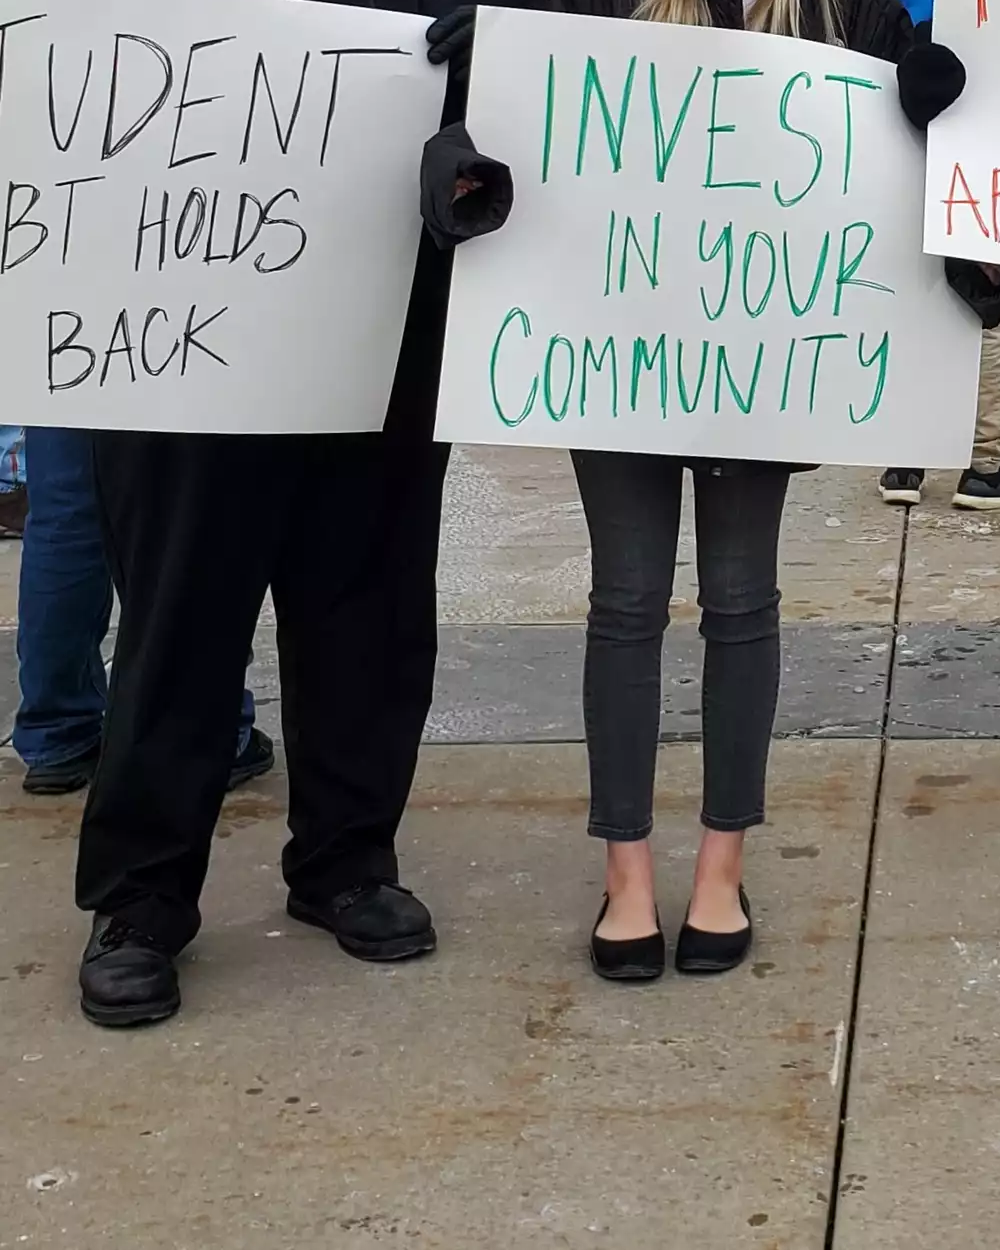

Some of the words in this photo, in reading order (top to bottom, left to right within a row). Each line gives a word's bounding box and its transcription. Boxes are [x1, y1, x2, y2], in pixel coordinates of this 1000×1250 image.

[541, 54, 881, 208] INVEST
[136, 187, 306, 273] HOLDS
[604, 210, 661, 295] IN
[698, 221, 895, 321] YOUR
[47, 305, 227, 394] BACK
[489, 306, 889, 427] COMMUNITY
